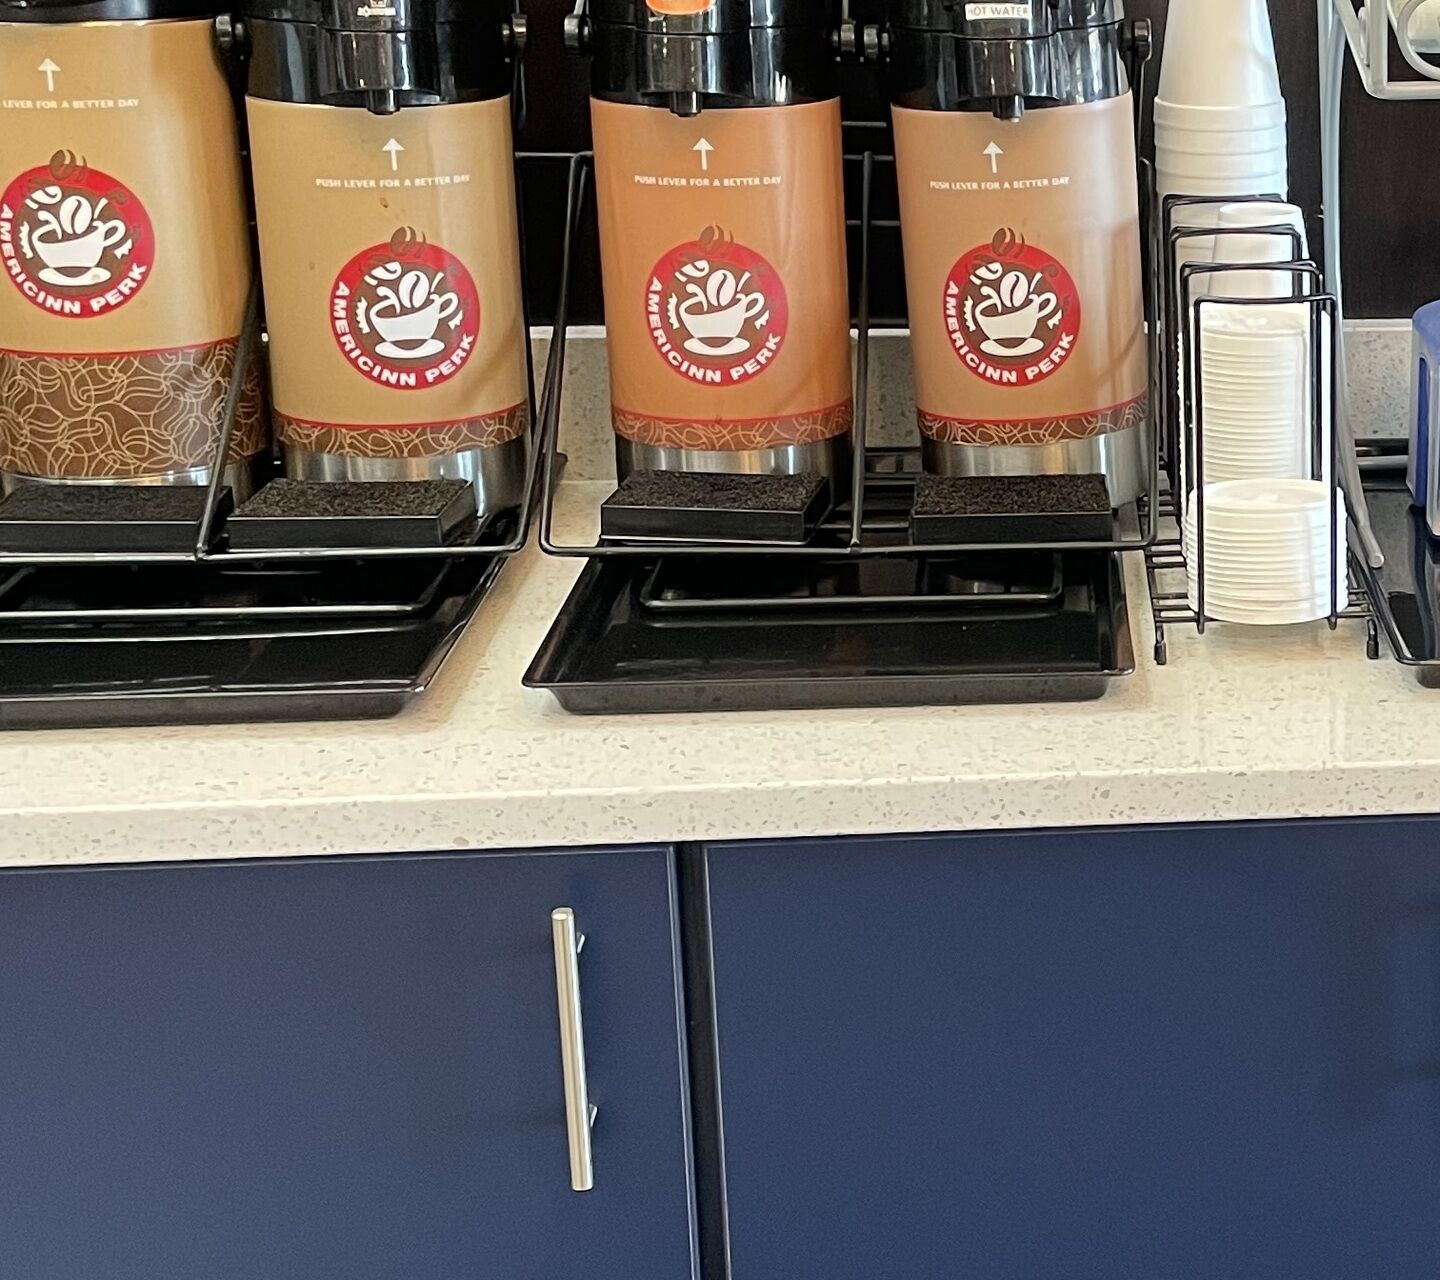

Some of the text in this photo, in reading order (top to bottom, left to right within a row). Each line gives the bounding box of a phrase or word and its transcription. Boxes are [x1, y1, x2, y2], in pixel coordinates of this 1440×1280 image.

[968, 6, 1029, 17] HOT WATER
[3, 99, 139, 109] LEVER FOR A BETTER DAY
[315, 178, 341, 188] PUSH
[344, 179, 377, 188] LEVER
[379, 179, 400, 188] FOR
[414, 176, 451, 187] BETTER
[453, 174, 471, 184] DAY
[634, 175, 656, 185] PUSH
[658, 177, 687, 186] LEVER
[689, 178, 710, 187] FOR
[723, 176, 760, 187] BETTER
[763, 175, 782, 185] DAY
[929, 180, 949, 190] PUSH
[951, 181, 978, 190] LEVER
[981, 181, 1000, 190] FOR
[1013, 178, 1049, 189] BETTER
[1052, 176, 1070, 186] DAY
[0, 202, 148, 315] AMERICINN PERK
[332, 280, 475, 387] AMERICINN PERK
[646, 275, 782, 384] AMERICINN PERK
[945, 280, 1075, 384] AMERICINN PERK
